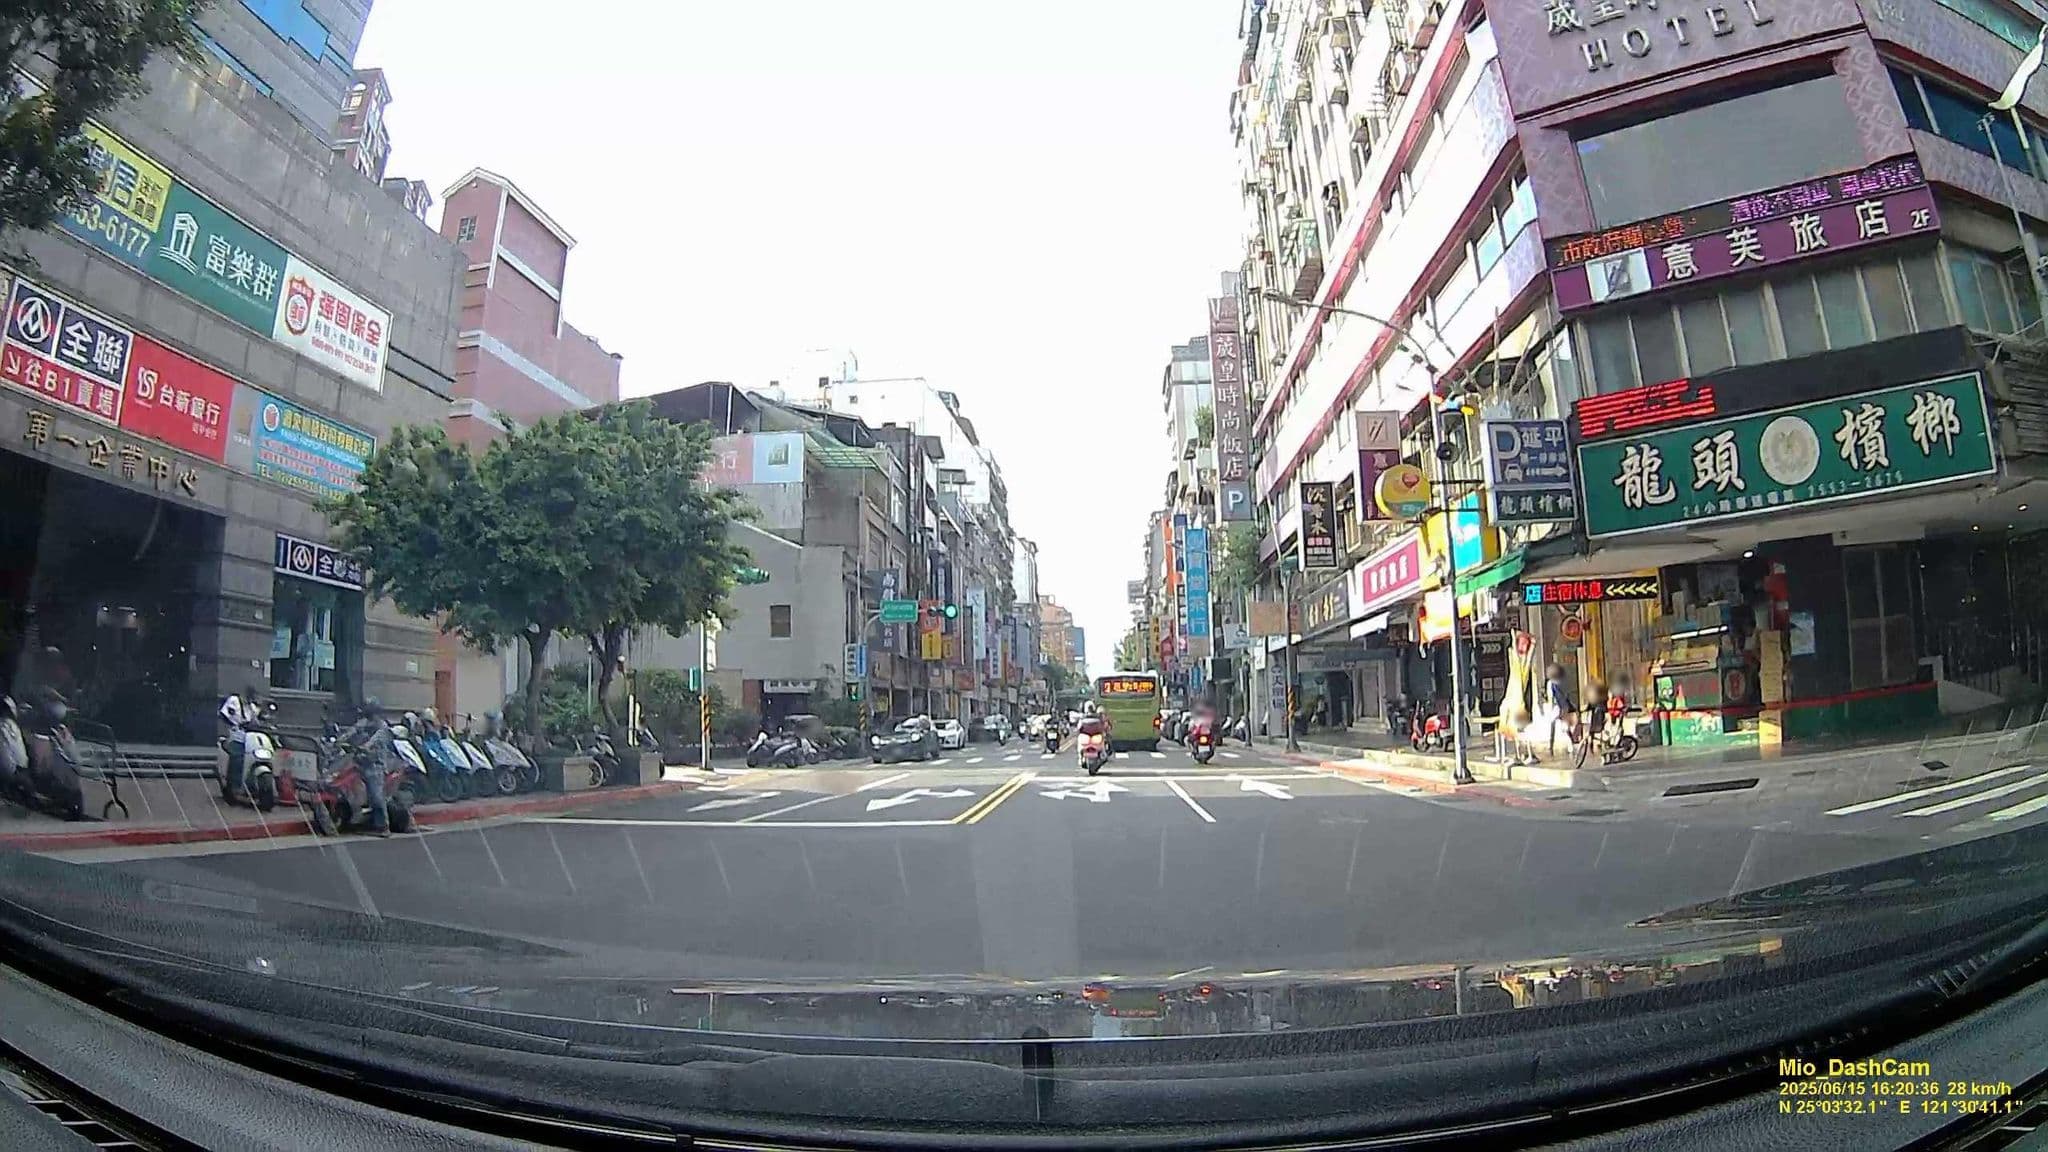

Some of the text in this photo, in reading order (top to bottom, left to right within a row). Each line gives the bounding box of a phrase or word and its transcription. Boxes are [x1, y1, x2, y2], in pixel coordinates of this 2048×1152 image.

[1580, 0, 1774, 72] HOTEL
[205, 234, 278, 302] 富樂群
[1662, 199, 1931, 281] 意芙旅店 2F
[61, 320, 123, 375] 全聯
[159, 383, 221, 426] 台新銀行
[23, 408, 199, 497] 第一企業中心
[1488, 424, 1522, 483] P
[1228, 490, 1244, 512] P
